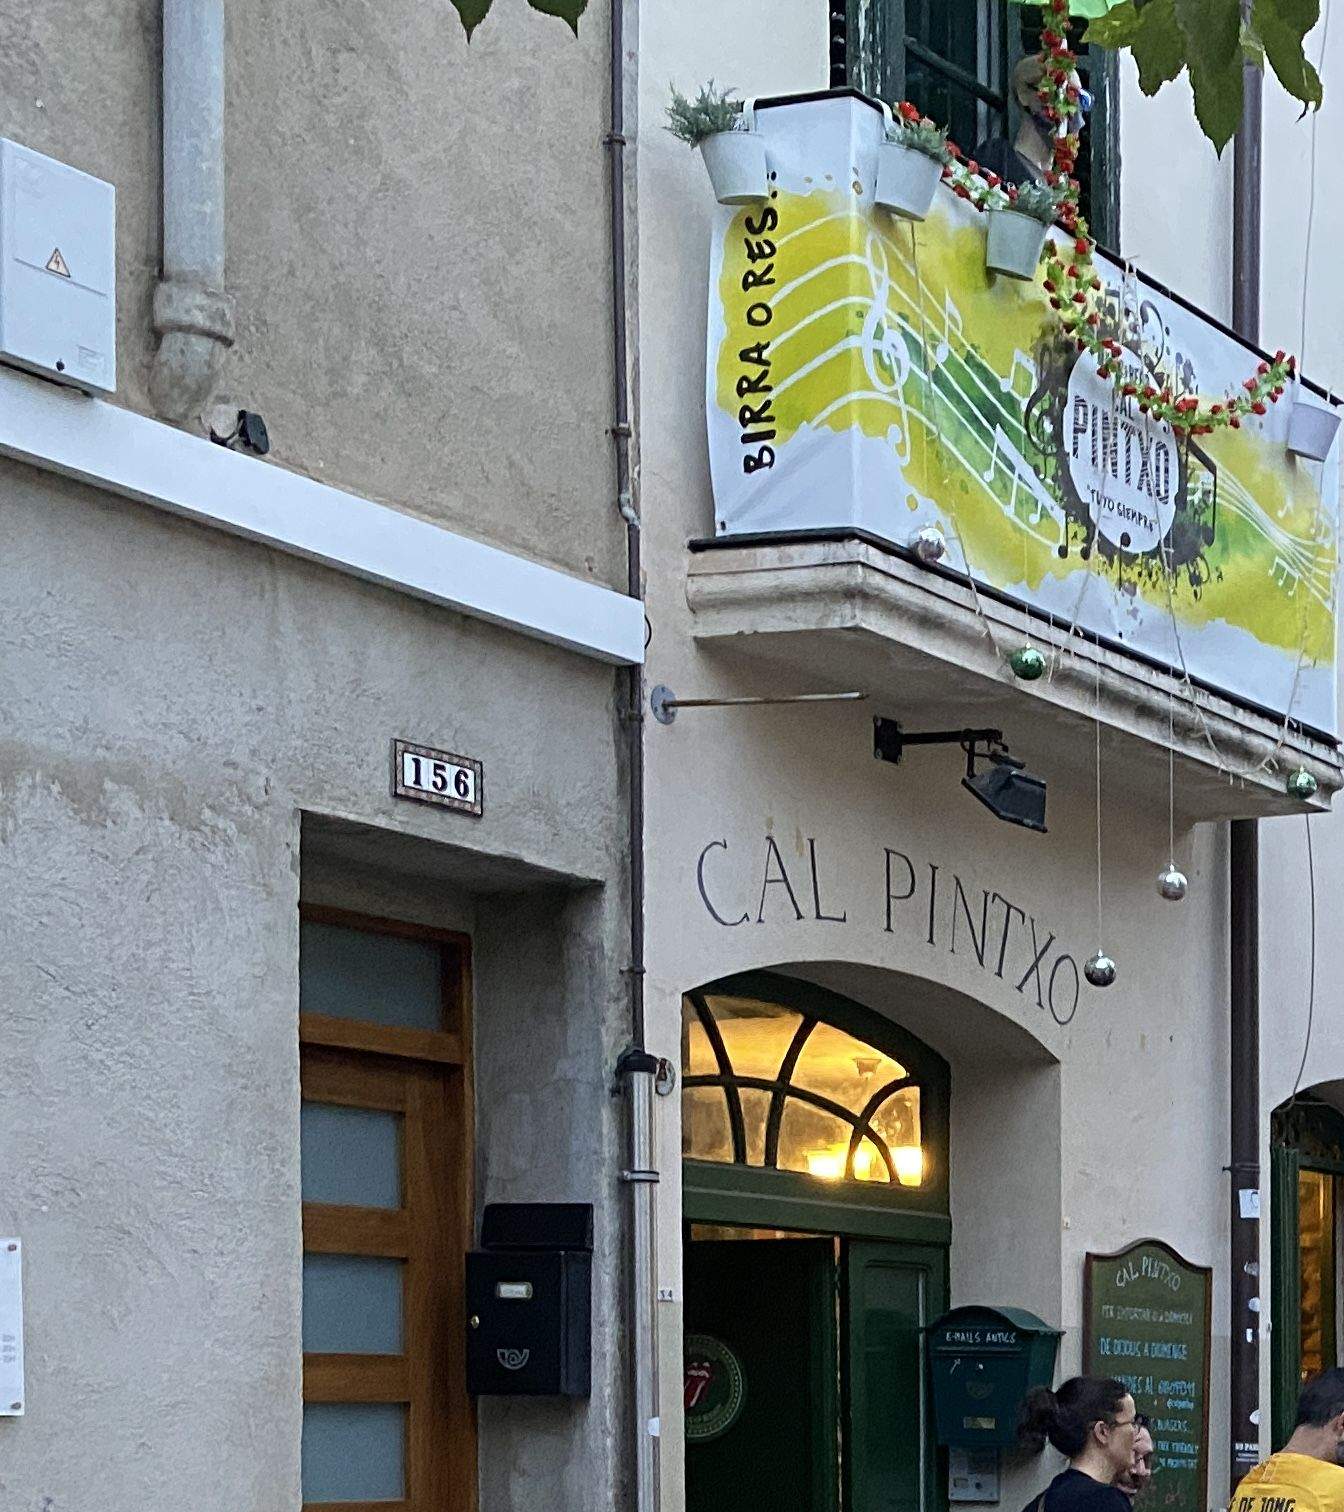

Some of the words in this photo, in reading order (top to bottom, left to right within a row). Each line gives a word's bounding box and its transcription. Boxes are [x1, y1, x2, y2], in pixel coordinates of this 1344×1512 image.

[736, 341, 777, 474] BIRRA
[1071, 395, 1170, 505] PINTXO
[411, 756, 470, 798] 156
[883, 846, 1081, 1026] PINTXO
[1116, 1262, 1139, 1288] CAL
